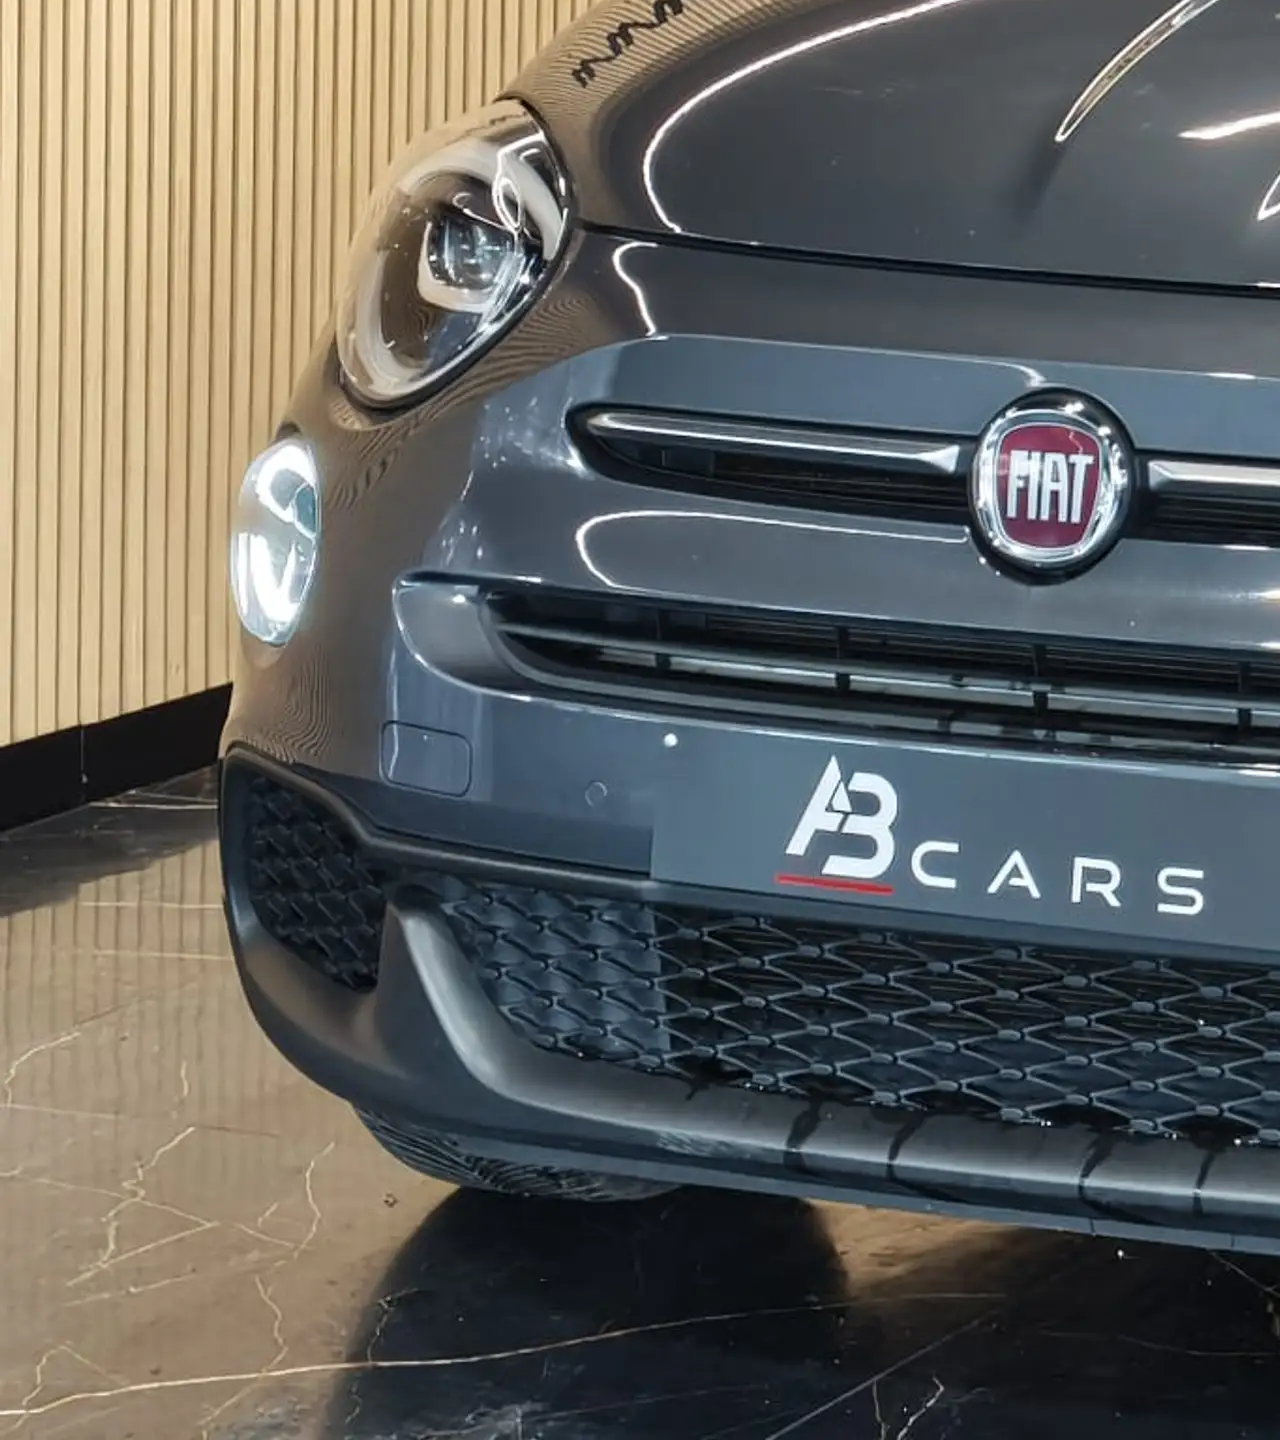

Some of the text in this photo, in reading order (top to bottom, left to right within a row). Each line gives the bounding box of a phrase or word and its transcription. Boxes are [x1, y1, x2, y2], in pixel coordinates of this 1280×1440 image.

[1006, 449, 1094, 523] FIAT
[785, 755, 1205, 916] AB CARS
